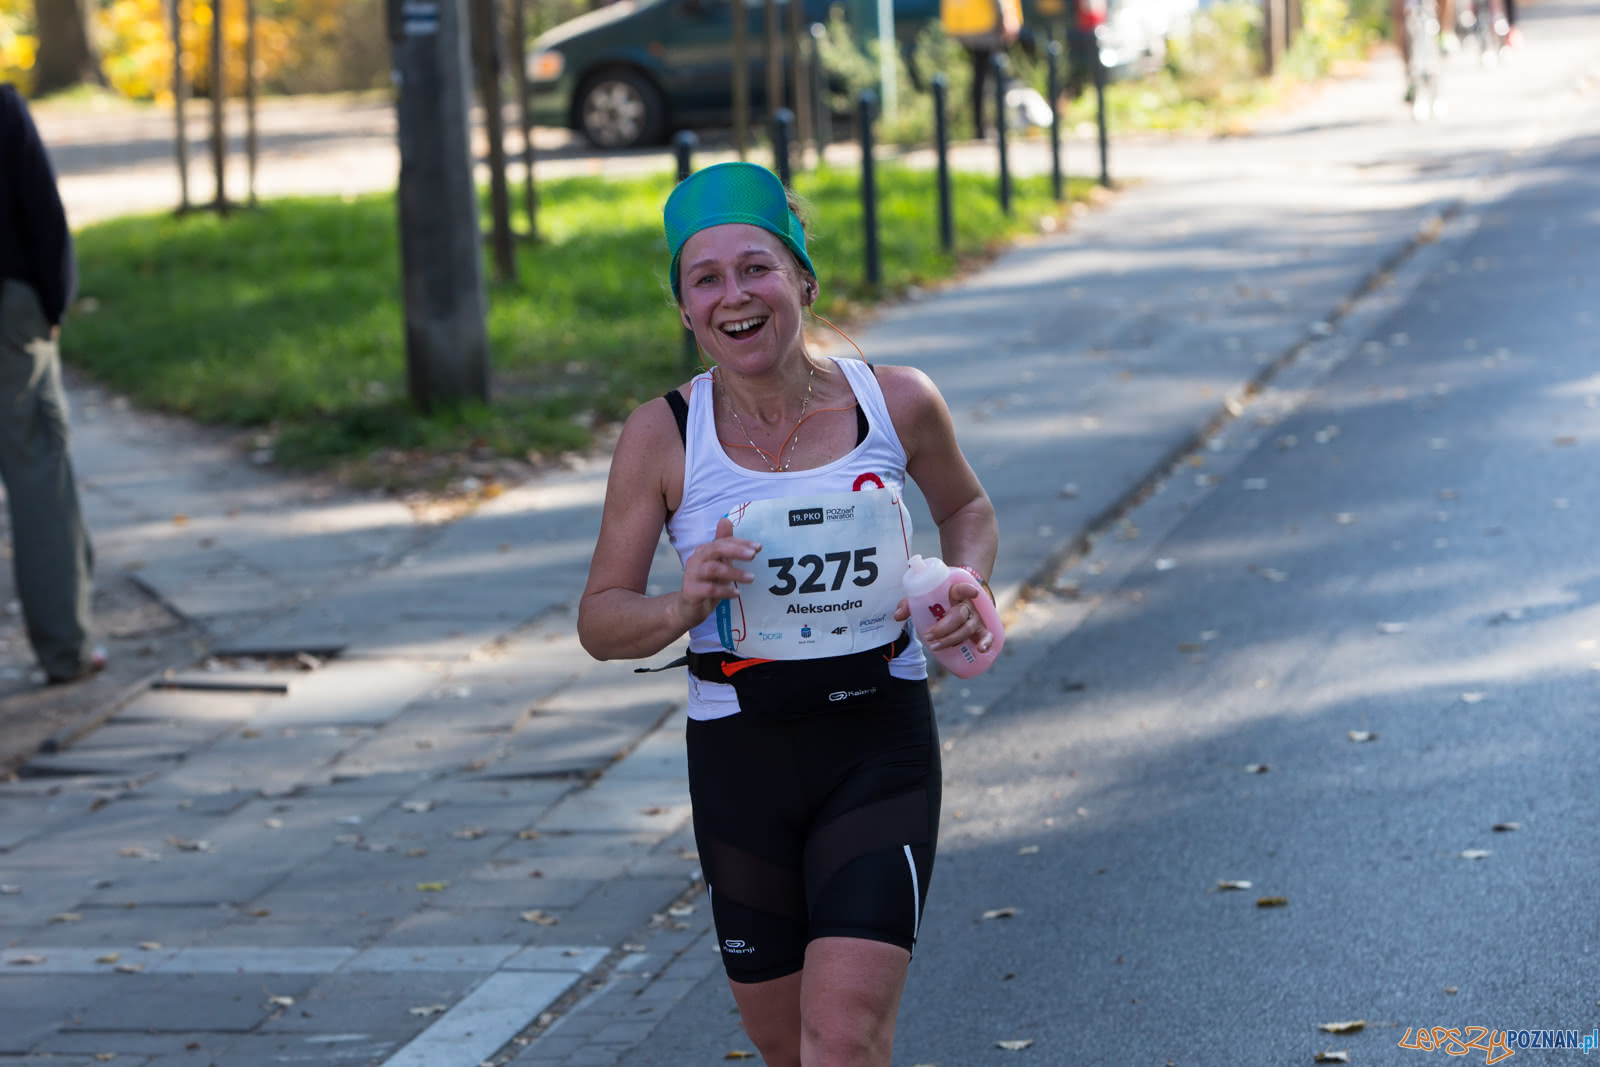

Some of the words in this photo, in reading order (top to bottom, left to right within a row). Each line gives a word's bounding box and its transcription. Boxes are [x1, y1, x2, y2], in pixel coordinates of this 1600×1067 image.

[826, 513, 855, 521] maraton
[768, 547, 879, 596] 3275
[786, 600, 863, 614] Aleksandra
[831, 626, 848, 635] 4F
